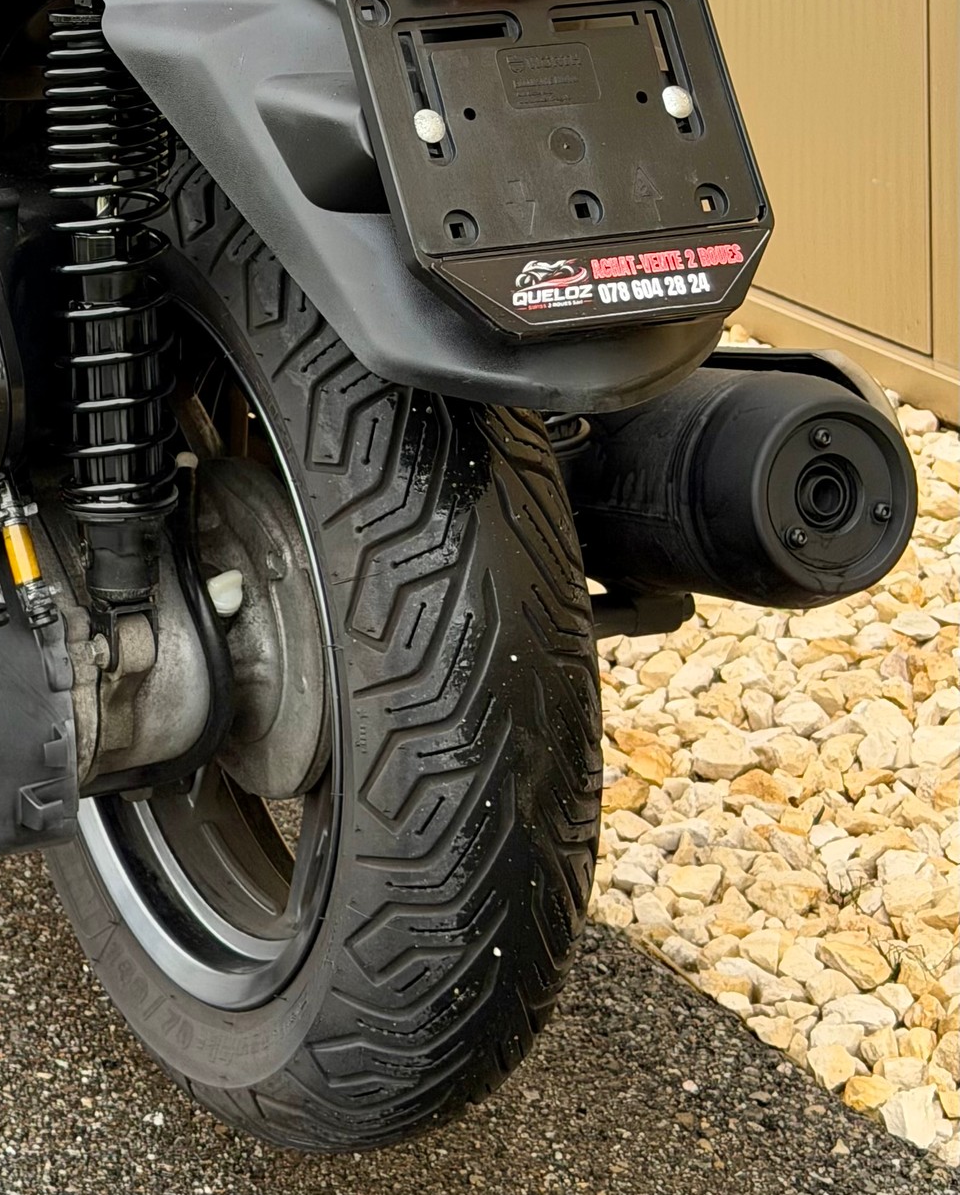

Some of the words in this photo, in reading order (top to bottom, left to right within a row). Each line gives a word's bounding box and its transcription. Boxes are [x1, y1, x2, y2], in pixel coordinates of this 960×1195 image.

[590, 249, 685, 280] ACHAT-VENTE
[684, 248, 698, 269] 2
[696, 243, 744, 268] ROUES
[512, 284, 593, 306] QUELOZ
[597, 281, 631, 304] 078
[630, 277, 664, 300] 604
[663, 275, 687, 296] 28
[687, 272, 711, 294] 24
